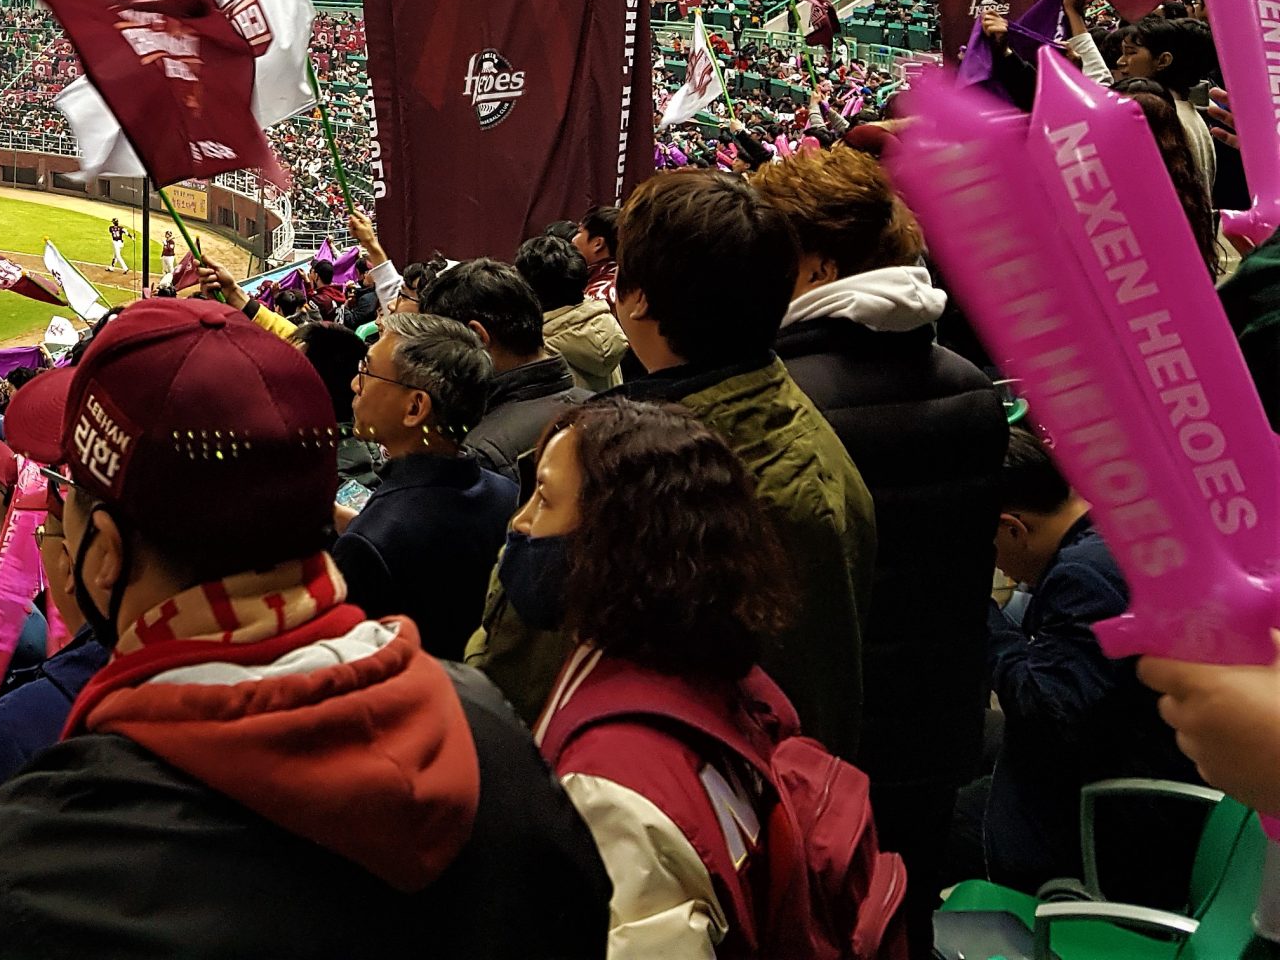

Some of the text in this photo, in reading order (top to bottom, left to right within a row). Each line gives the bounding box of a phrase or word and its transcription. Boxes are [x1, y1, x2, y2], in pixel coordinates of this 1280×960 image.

[1047, 120, 1260, 537] NEXEN HEROES
[74, 414, 121, 487] 리한
[86, 394, 132, 454] LEEHAN
